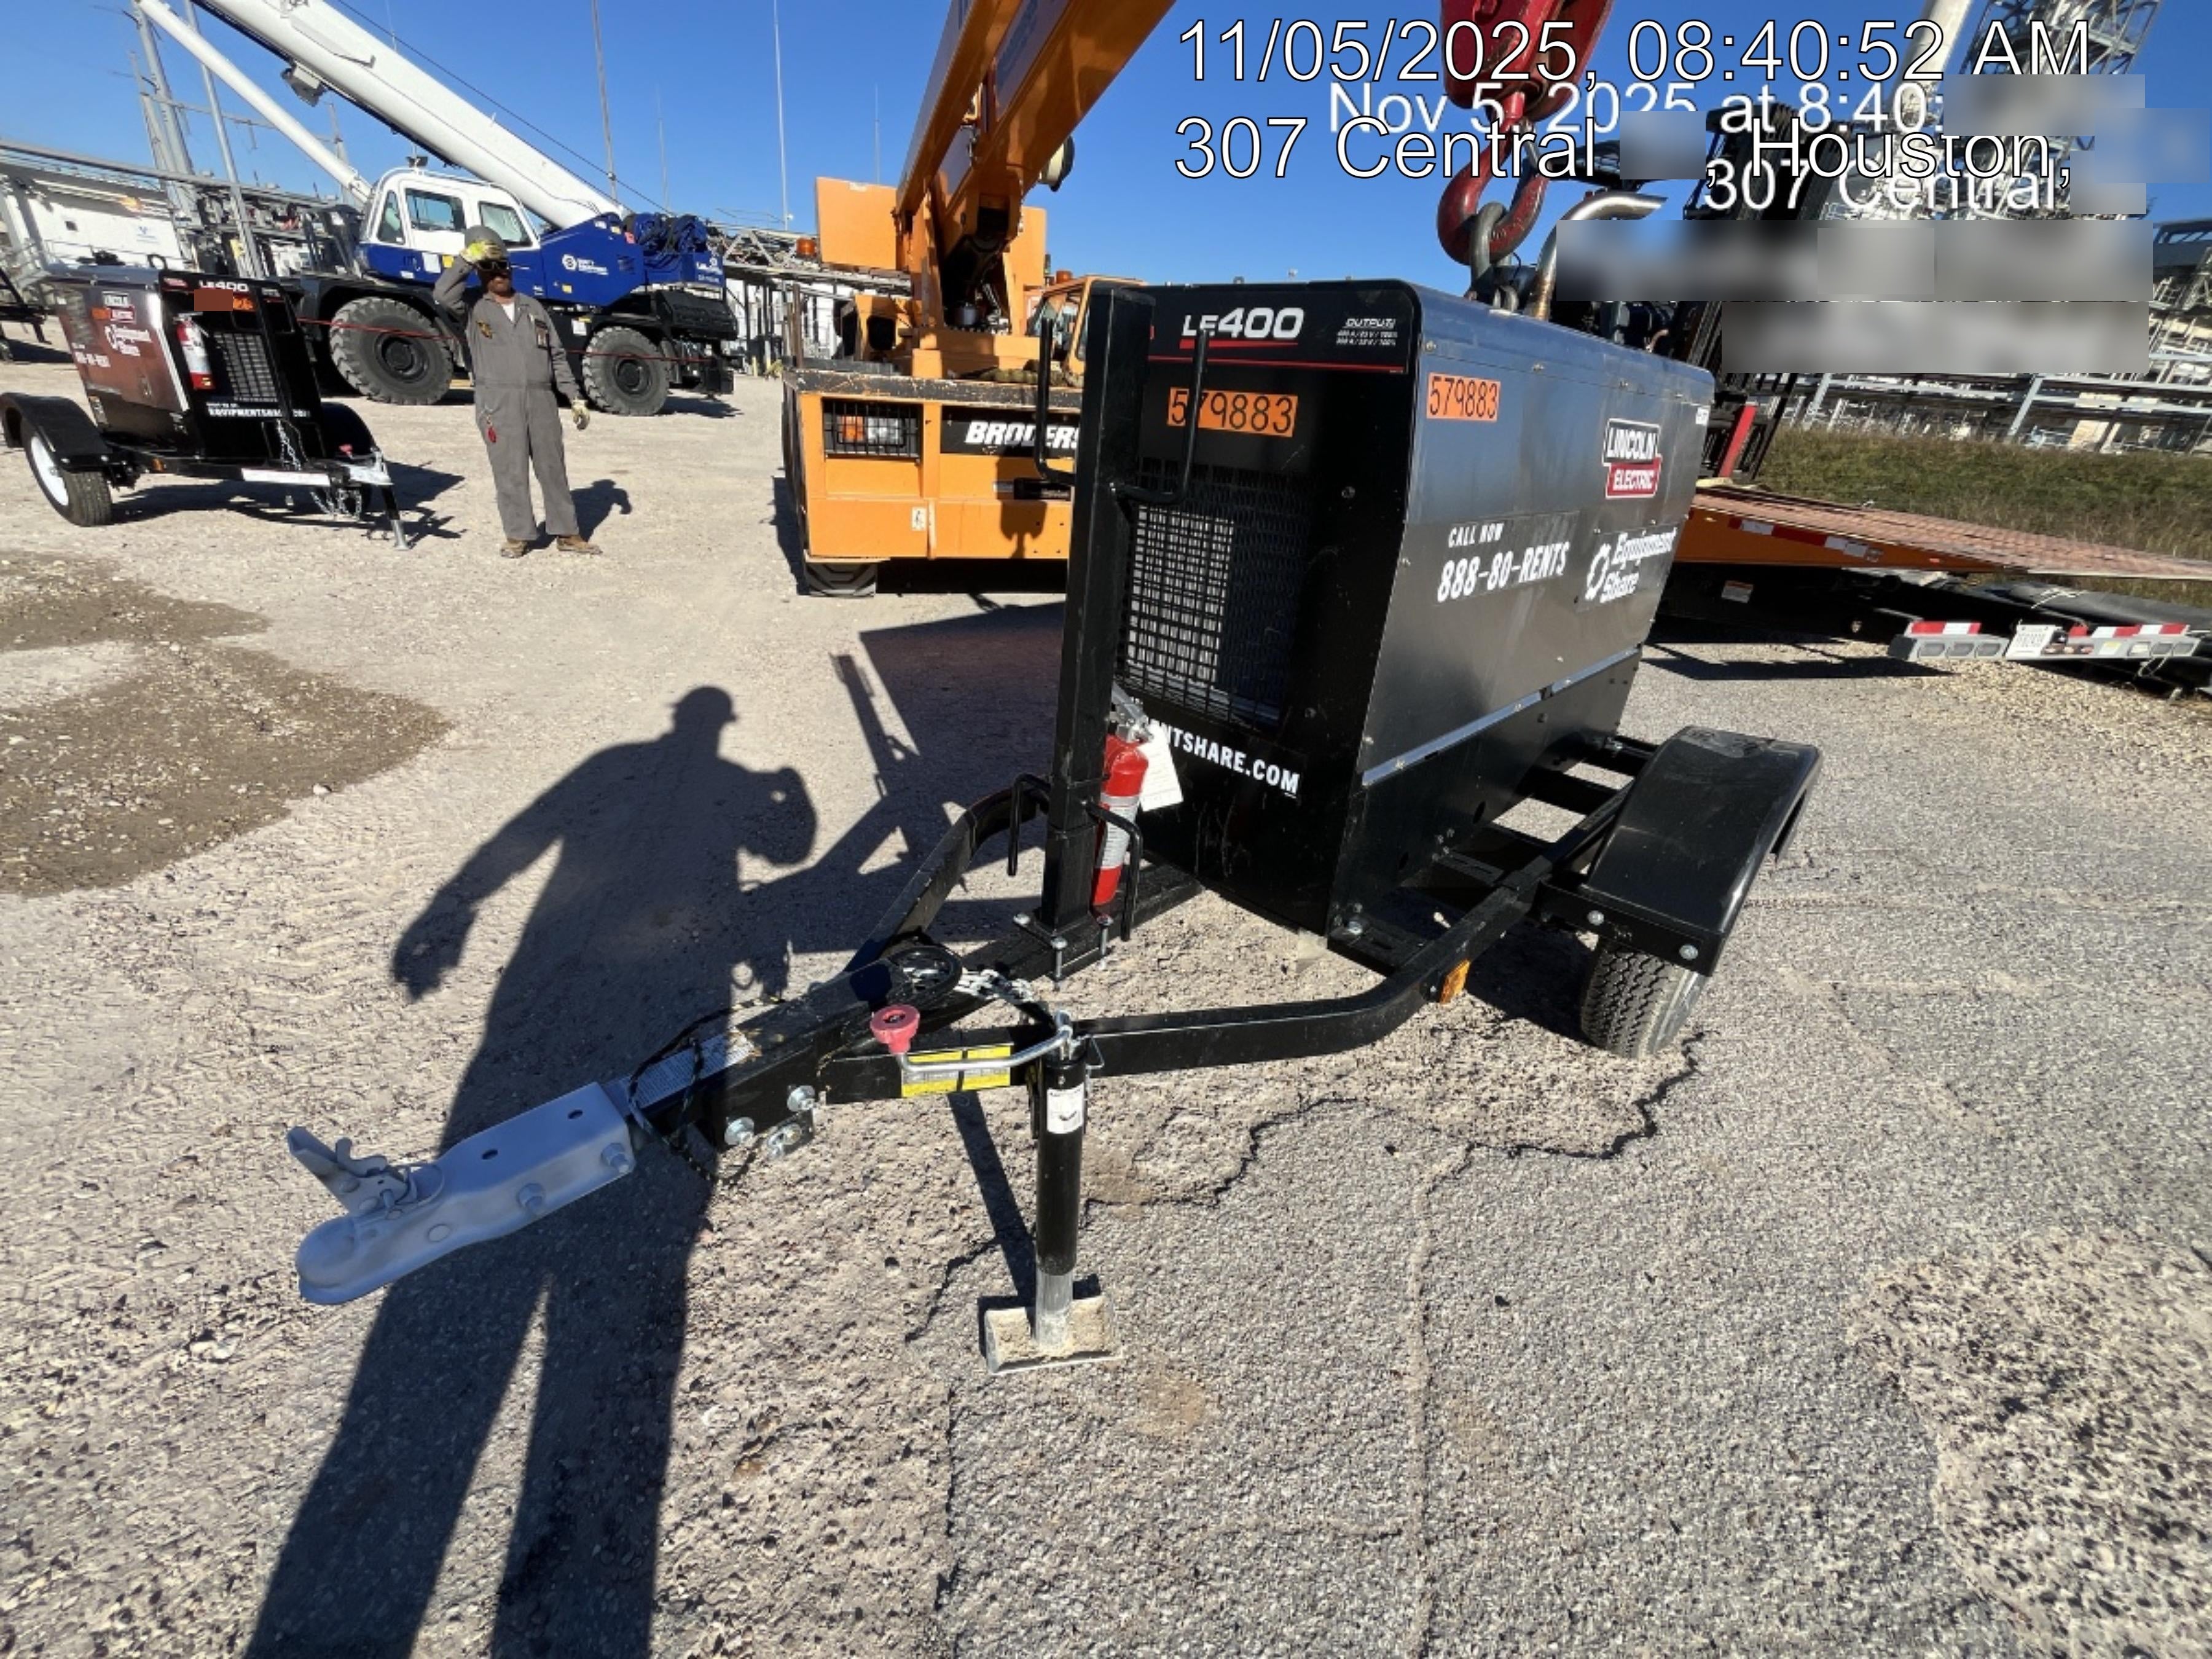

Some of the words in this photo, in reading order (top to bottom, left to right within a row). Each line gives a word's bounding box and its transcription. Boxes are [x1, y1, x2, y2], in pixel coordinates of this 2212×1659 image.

[1430, 375, 1497, 418] 579883
[1605, 427, 1657, 460] LINCOLN
[1612, 469, 1655, 492] ELECTRIC
[1448, 525, 1477, 548] CALL
[1478, 522, 1504, 544] NOW
[1610, 526, 1678, 571] Equipment
[1437, 541, 1571, 603] 888-80-RENTS
[1599, 571, 1639, 603] Share
